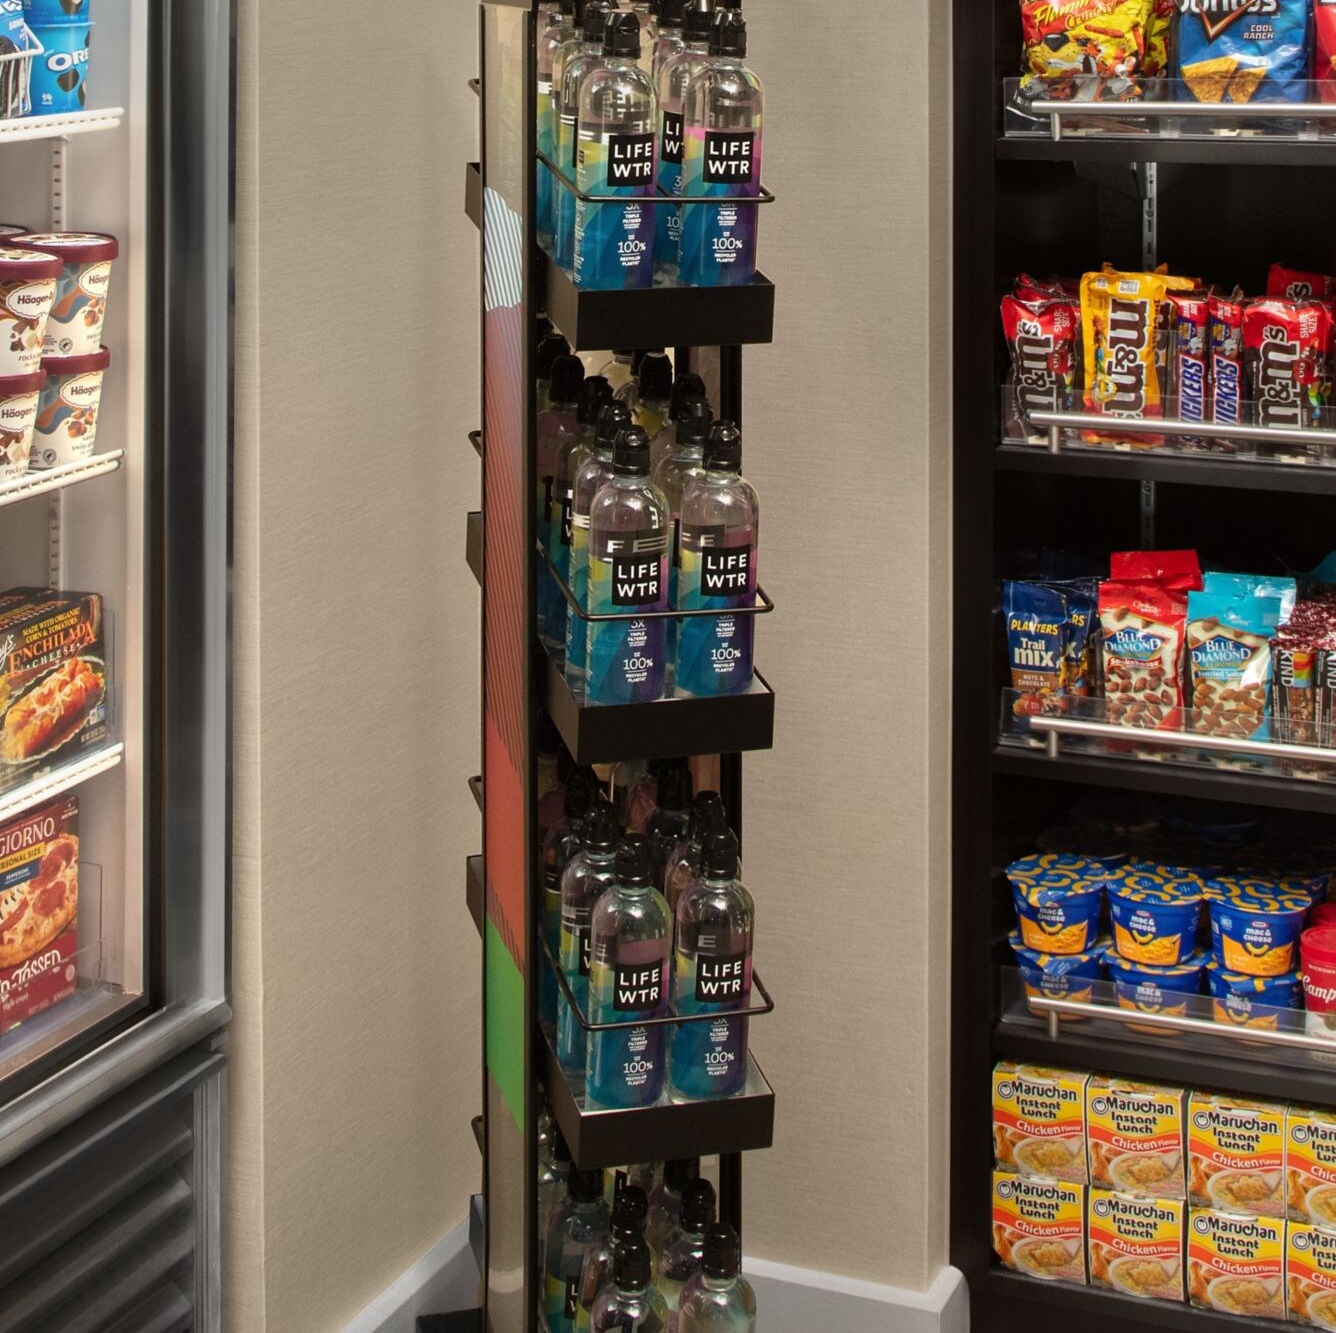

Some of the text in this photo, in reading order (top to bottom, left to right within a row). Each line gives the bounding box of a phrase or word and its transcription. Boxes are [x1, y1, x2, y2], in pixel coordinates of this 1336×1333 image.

[1065, 0, 1118, 30] Crunchy
[1250, 24, 1274, 32] COOL
[1243, 32, 1274, 40] RANCH
[47, 48, 89, 72] ORE
[665, 120, 680, 136] LI
[614, 143, 652, 158] LIFE
[709, 141, 750, 156] LIFE
[613, 162, 651, 177] WTR
[708, 160, 749, 174] WTR
[617, 240, 646, 253] 100%
[712, 237, 743, 249] 100%
[89, 274, 108, 286] Häag
[1300, 312, 1309, 339] SHARE
[1309, 315, 1318, 334] SIZE
[70, 385, 100, 396] Häagen
[1181, 357, 1203, 423] ICKERS
[1, 407, 35, 419] Häagen
[707, 554, 747, 570] LIFE
[618, 562, 658, 578] LIFE
[706, 573, 746, 588] WTR
[617, 581, 657, 597] WTR
[22, 624, 39, 636] MADE
[26, 632, 42, 644] CORN
[1020, 637, 1046, 651] Trail
[1104, 637, 1161, 652] DIAMOND
[8, 620, 97, 678] ENCHILADA
[1205, 640, 1235, 652] BLUE
[711, 648, 741, 660] 100%
[1014, 647, 1055, 667] mix
[1192, 647, 1251, 663] DIAMOND
[623, 657, 653, 670] 100%
[1110, 657, 1159, 667] Smokehouse
[1281, 650, 1294, 687] KIND
[1018, 679, 1051, 687] CHOCOLATE
[0, 817, 54, 857] GIORNO
[27, 846, 41, 858] SIZE
[1037, 913, 1066, 923] cheese
[1243, 934, 1273, 943] cheese
[702, 960, 742, 977] LIFE
[0, 950, 61, 1003] D-TOSSED
[620, 968, 660, 986] LIFE
[701, 979, 741, 995] WTR
[1303, 975, 1336, 1004] Camp
[619, 987, 659, 1004] WTR
[704, 1052, 735, 1064] 100%
[623, 1061, 653, 1074] 100%
[1012, 1081, 1077, 1101] Maruchan
[1016, 1096, 1061, 1110] Instant
[1106, 1096, 1174, 1115] Maruchan
[1021, 1107, 1057, 1119] Lunch
[1111, 1112, 1157, 1125] Instant
[1016, 1120, 1060, 1135] Chicken
[1116, 1122, 1153, 1134] Lunch
[1208, 1112, 1278, 1133] Maruchan
[1213, 1127, 1260, 1143] Instant
[1112, 1136, 1158, 1150] Chicken
[1218, 1138, 1255, 1152] Lunch
[1311, 1141, 1336, 1154] Inst
[1212, 1152, 1259, 1168] Chicken
[1310, 1166, 1336, 1182] Chic
[1011, 1181, 1076, 1202] Maruchan
[1016, 1196, 1060, 1211] Instant
[1107, 1199, 1175, 1222] Maruchan
[1020, 1207, 1055, 1220] Lunch
[1015, 1220, 1059, 1235] Chicken
[1113, 1214, 1158, 1230] Instant
[1207, 1217, 1276, 1240] Maruchan
[1118, 1225, 1154, 1239] Lunch
[1112, 1238, 1157, 1254] Chicken
[1212, 1232, 1259, 1249] Instant
[1217, 1243, 1254, 1258] Lunch
[1312, 1248, 1336, 1261] Inst
[1211, 1257, 1258, 1273] Chicken
[1311, 1272, 1336, 1288] Chic
